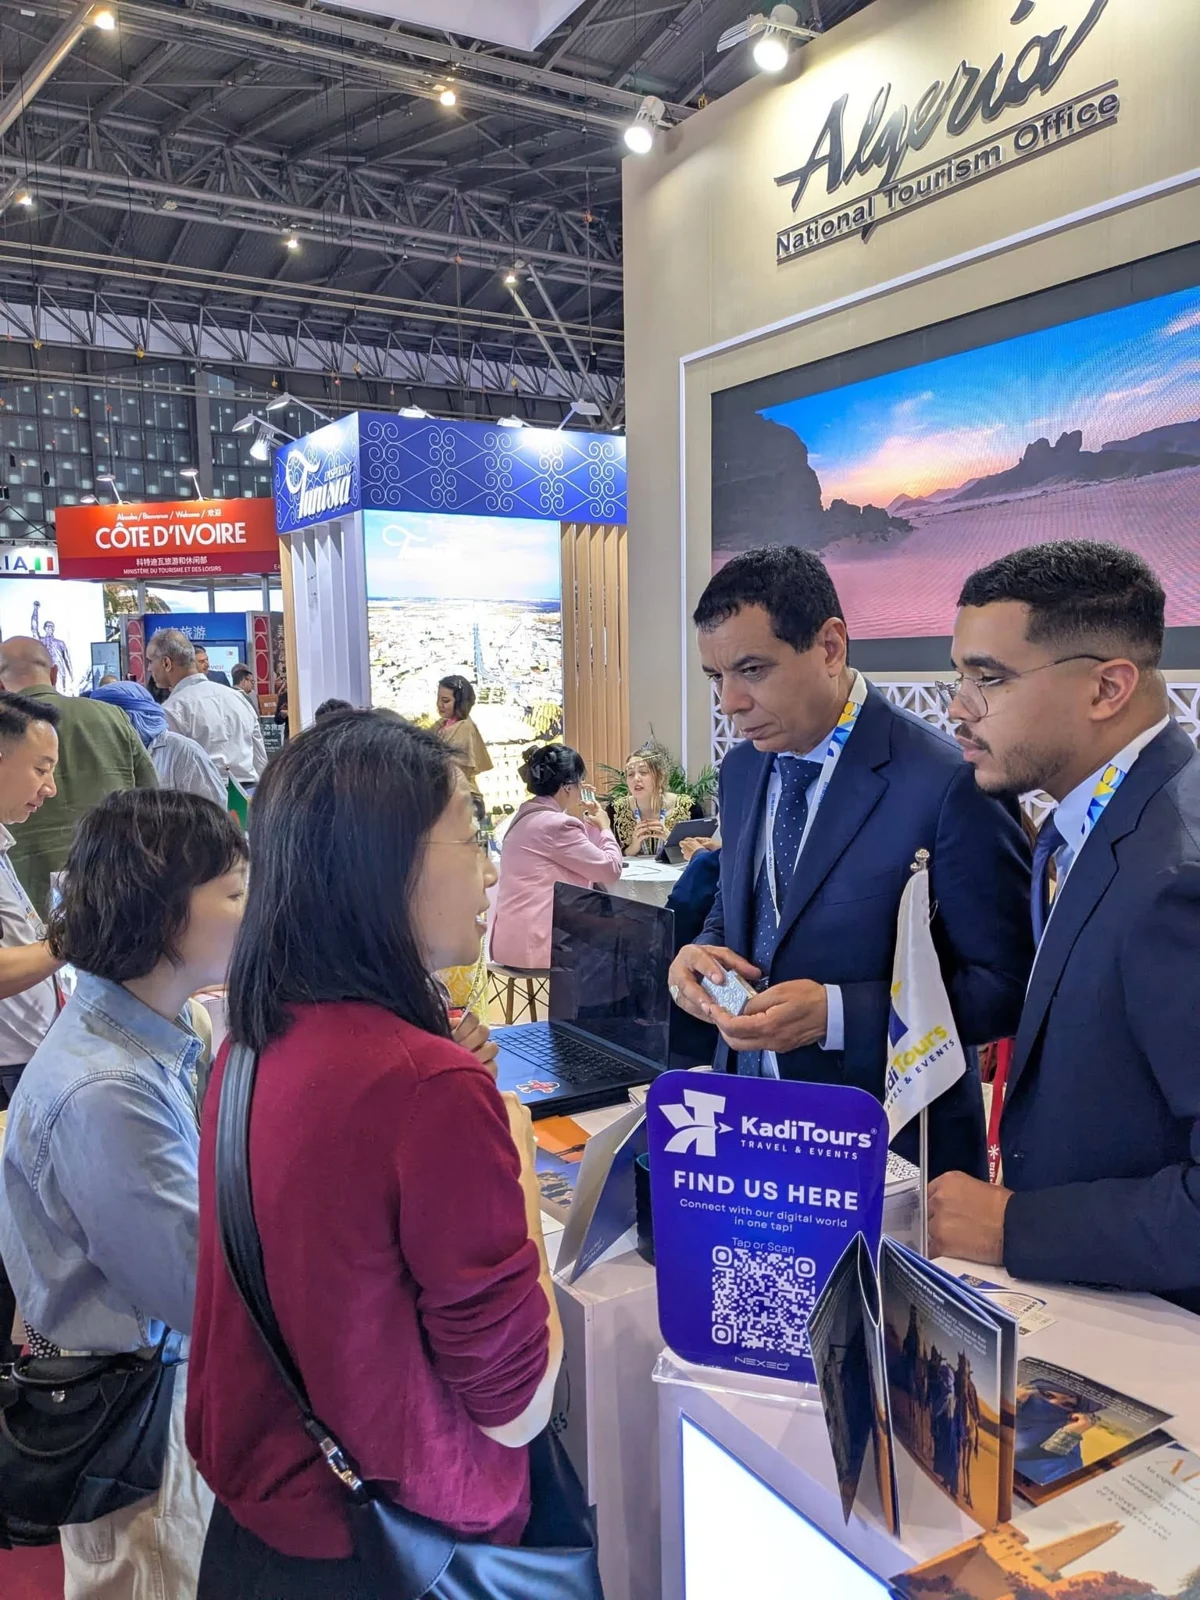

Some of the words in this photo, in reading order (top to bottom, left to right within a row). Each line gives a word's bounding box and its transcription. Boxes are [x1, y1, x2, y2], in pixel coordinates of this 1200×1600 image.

[774, 0, 1109, 244] Algeria
[776, 197, 875, 257] National
[884, 144, 1003, 209] Tourism
[1014, 93, 1119, 152] Office
[286, 449, 352, 519] Tunisia
[95, 522, 150, 549] CÔTE
[153, 522, 247, 547] D'IVOIRE
[158, 566, 184, 574] TOURISME
[202, 565, 222, 573] LOISIRS
[155, 625, 206, 640] 旅游
[904, 1076, 913, 1085] &
[915, 1038, 955, 1074] EVENTS
[741, 1140, 787, 1152] TRAVEL
[795, 1145, 801, 1154] &
[809, 1147, 858, 1160] EVENTS
[674, 1170, 735, 1195] FIND
[744, 1179, 778, 1200] US
[788, 1184, 858, 1211] HERE
[679, 1198, 726, 1213] Connect
[728, 1205, 752, 1216] with
[755, 1209, 774, 1218] our
[776, 1211, 812, 1224] digital
[815, 1217, 848, 1228] world
[734, 1216, 744, 1225] in
[747, 1220, 768, 1229] one
[770, 1222, 793, 1233] tap!
[731, 1236, 751, 1249] Tap
[753, 1242, 765, 1250] or
[767, 1242, 795, 1254] Scan
